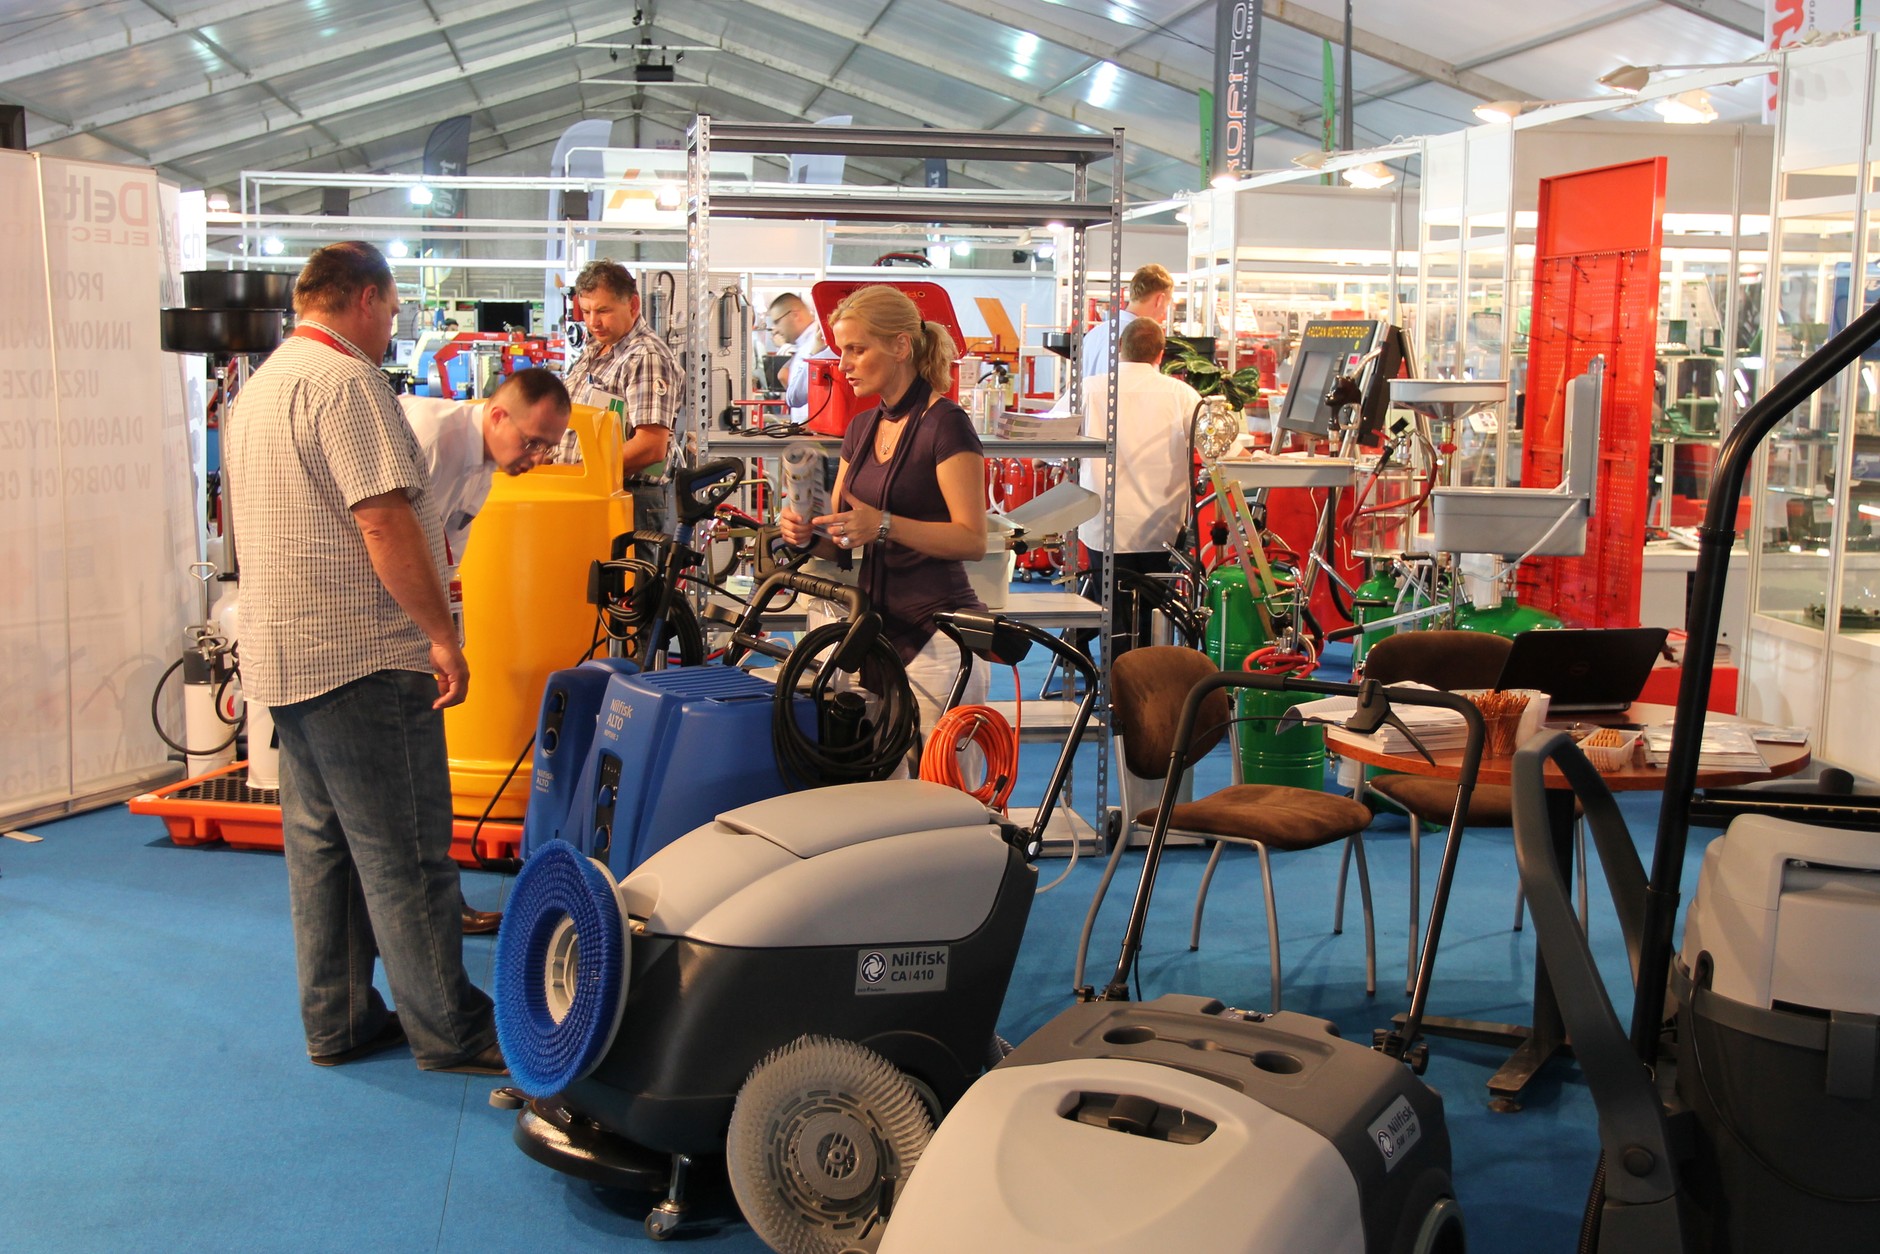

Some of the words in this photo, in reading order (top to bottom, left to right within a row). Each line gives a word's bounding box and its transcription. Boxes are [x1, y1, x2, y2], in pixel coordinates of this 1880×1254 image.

[611, 699, 633, 718] Nilfisk
[607, 713, 624, 731] ALTO
[536, 777, 549, 787] ALTO
[892, 951, 946, 967] Nilfisk
[1387, 1106, 1415, 1136] Nilfisk
